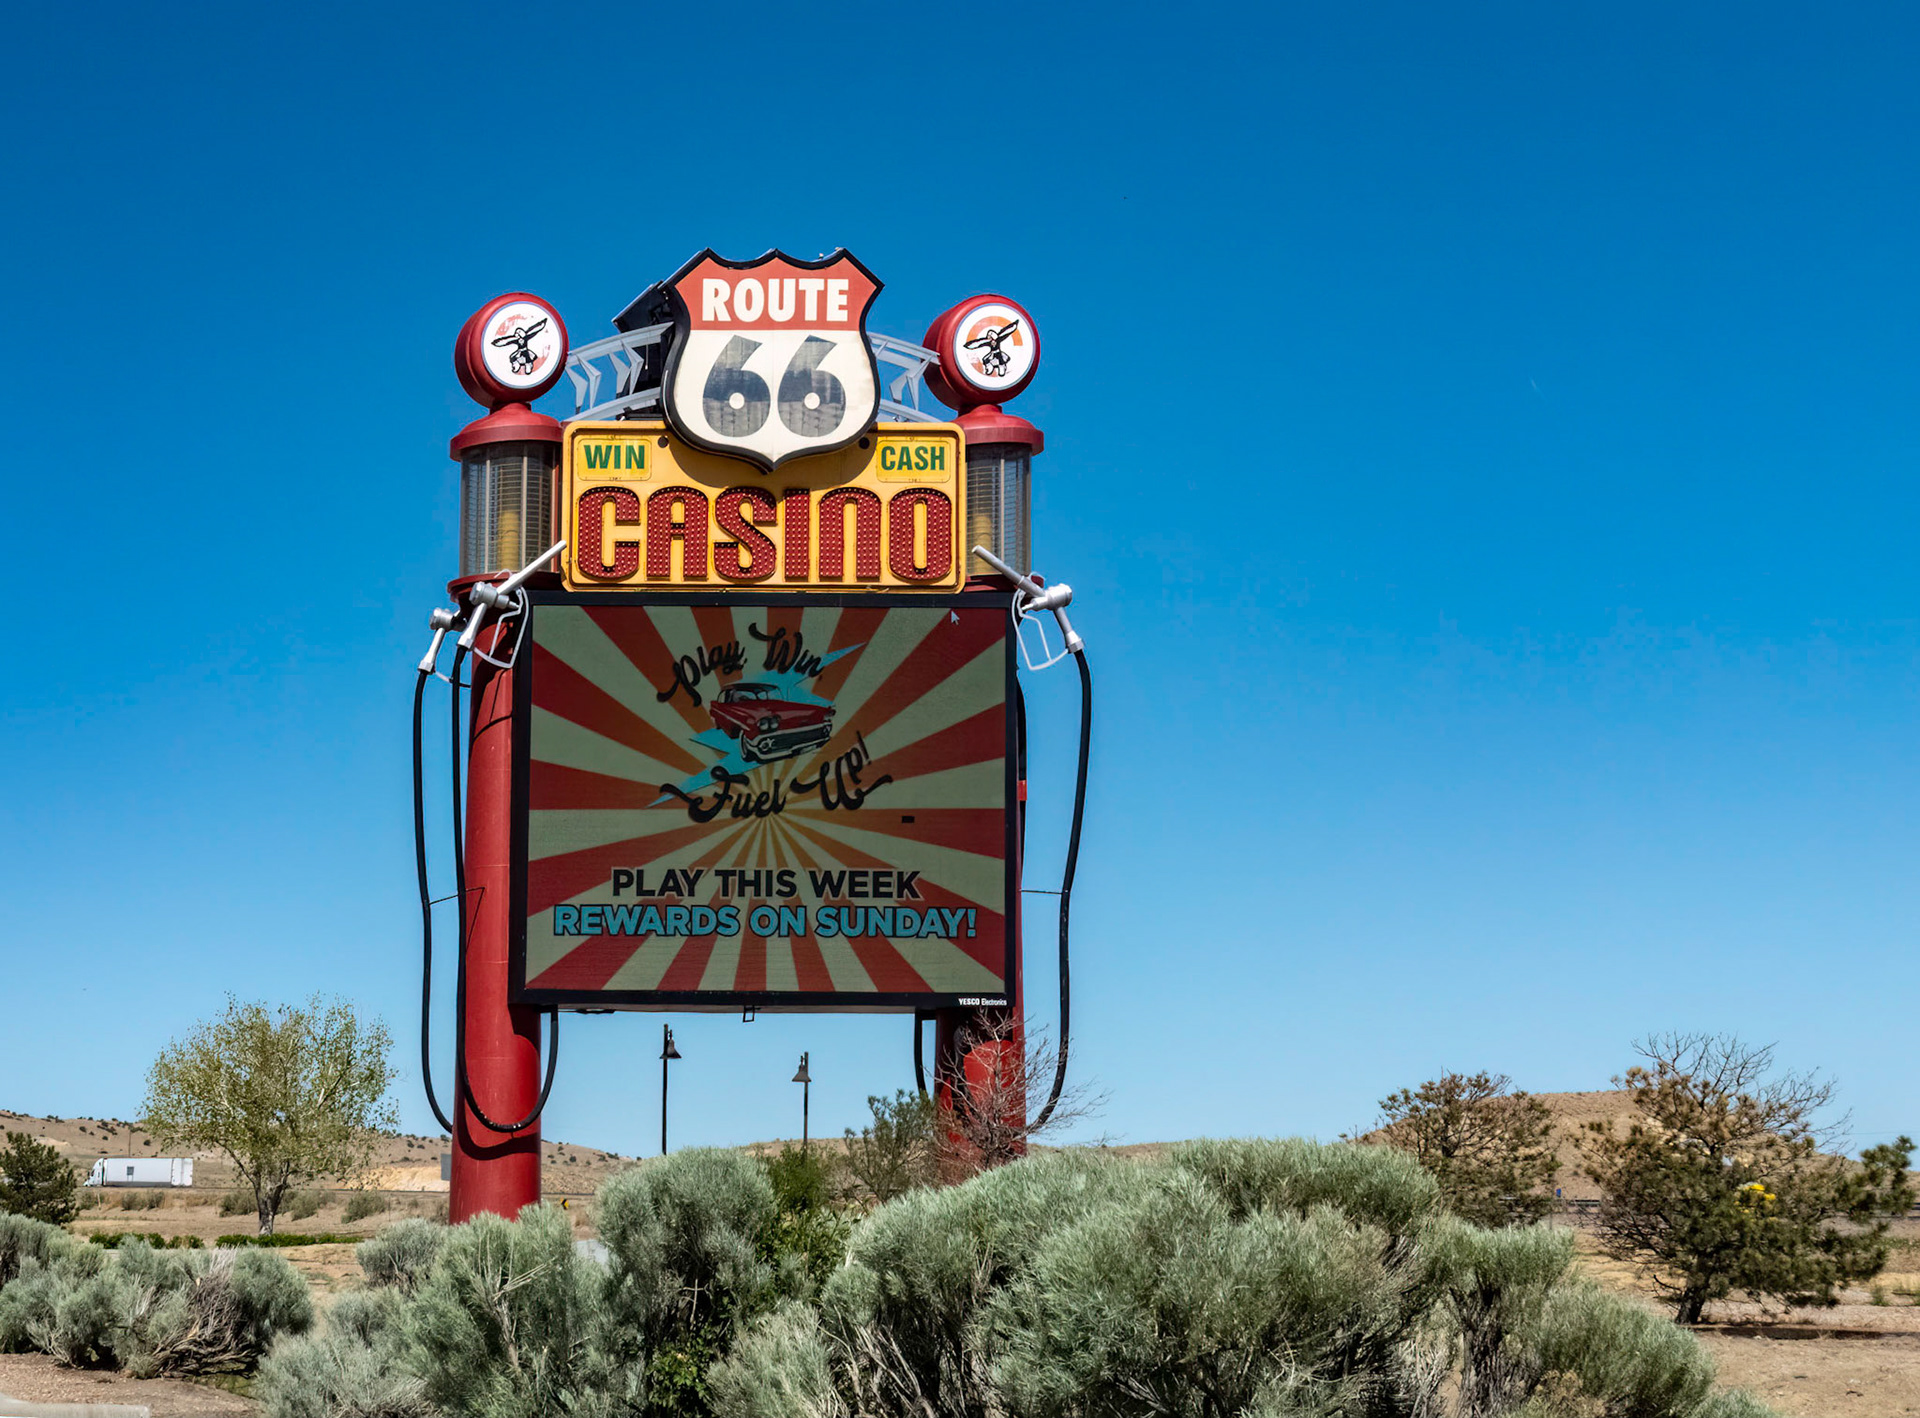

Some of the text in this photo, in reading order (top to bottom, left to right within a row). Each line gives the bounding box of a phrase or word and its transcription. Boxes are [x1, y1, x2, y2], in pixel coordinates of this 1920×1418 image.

[701, 278, 850, 322] ROUTE
[703, 335, 846, 438] 66
[583, 445, 645, 469] WIN
[881, 446, 945, 470] CASH
[577, 486, 952, 581] CASINO
[659, 765, 786, 823] Fuel
[612, 868, 921, 899] PLAY THIS WEEK
[553, 904, 977, 938] REWARDS ON SUNDAY!
[958, 998, 1007, 1006] YESCO Electronics
